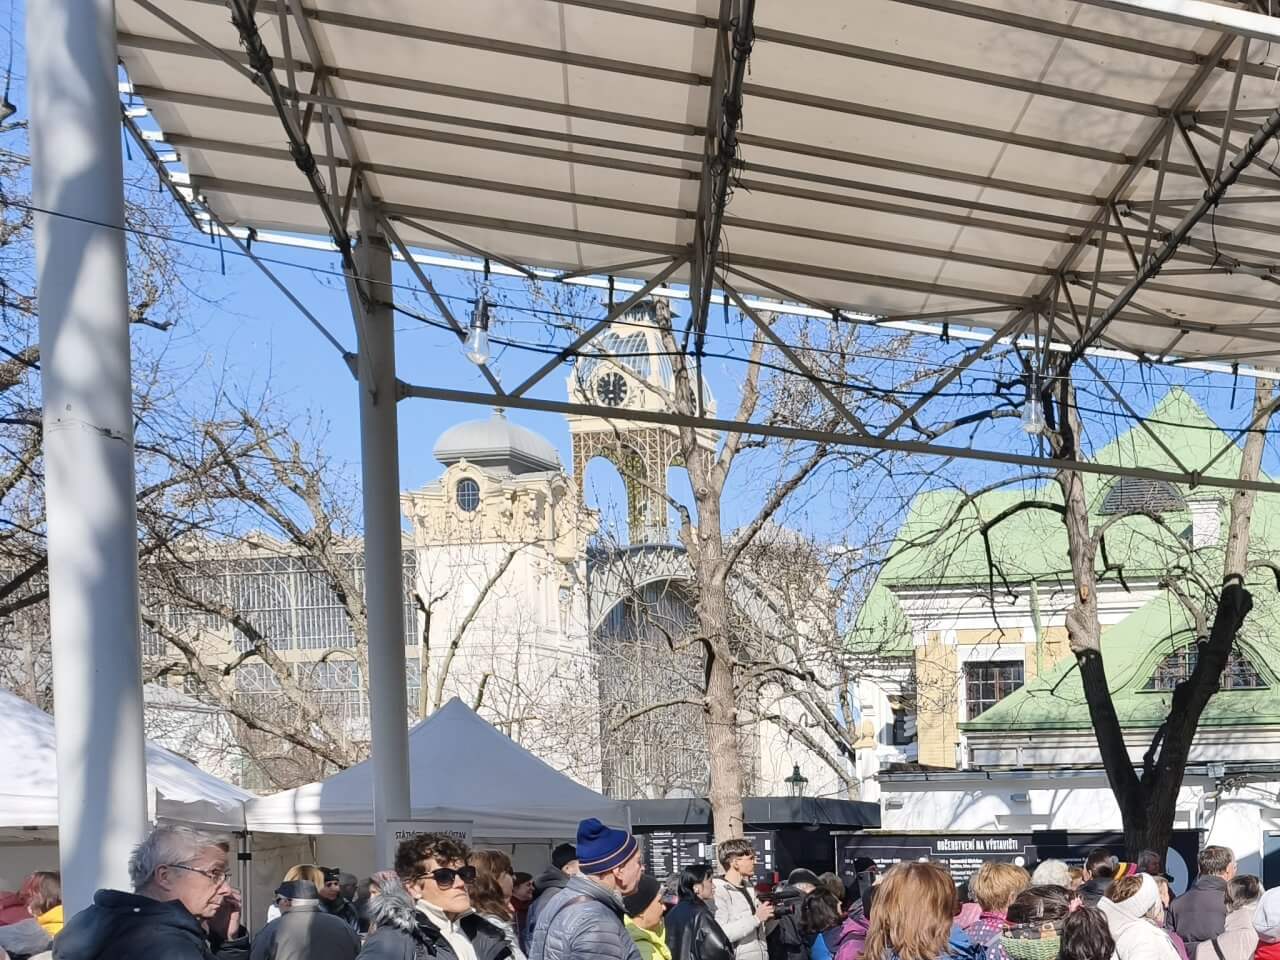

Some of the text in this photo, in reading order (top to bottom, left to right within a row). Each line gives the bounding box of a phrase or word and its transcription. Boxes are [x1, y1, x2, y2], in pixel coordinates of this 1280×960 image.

[936, 837, 1019, 851] OBČERSTVENÍ NA VÝSTAVIŠTI
